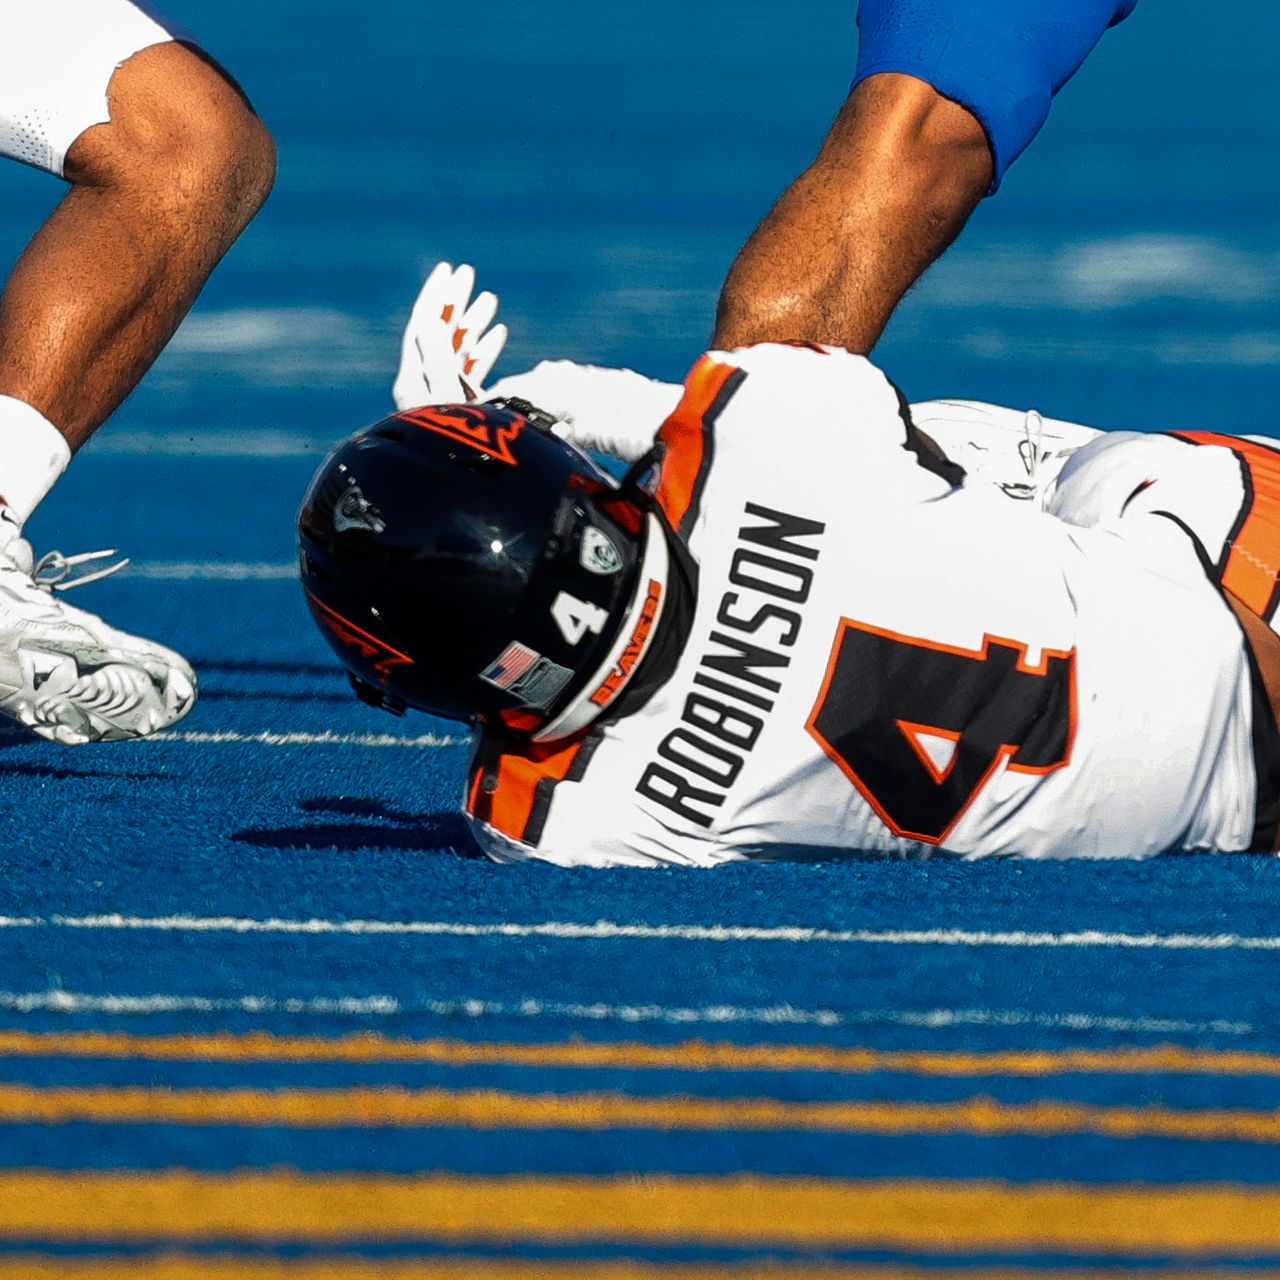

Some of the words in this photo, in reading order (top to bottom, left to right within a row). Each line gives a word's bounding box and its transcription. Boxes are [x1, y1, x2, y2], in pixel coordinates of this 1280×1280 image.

[550, 590, 610, 647] 4
[588, 578, 663, 708] BEAVERS
[635, 501, 826, 828] ROBINSON
[803, 615, 1079, 846] 4
